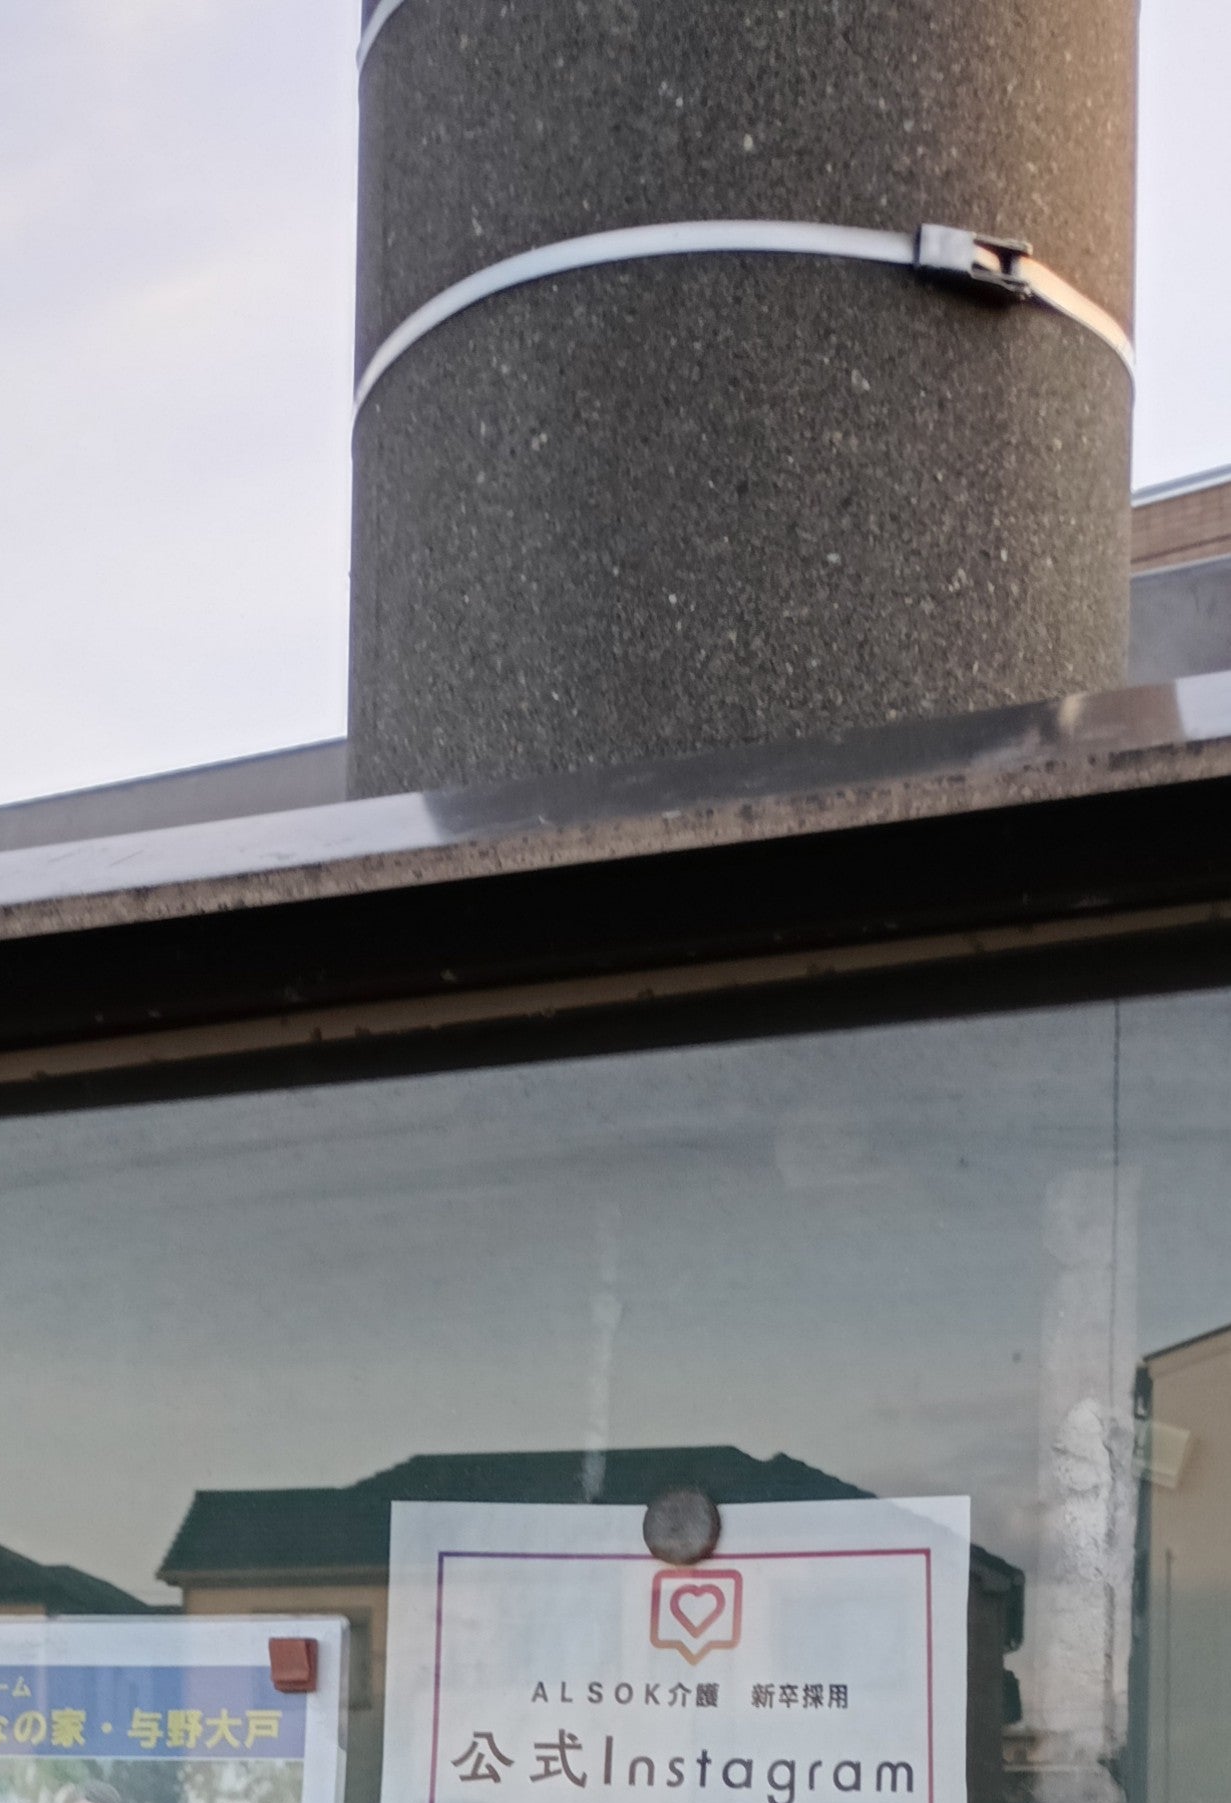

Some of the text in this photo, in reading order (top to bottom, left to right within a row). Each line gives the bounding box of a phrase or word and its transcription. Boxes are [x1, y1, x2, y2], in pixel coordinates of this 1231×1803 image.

[531, 1680, 850, 1711] ALSOK介護 新卒採用
